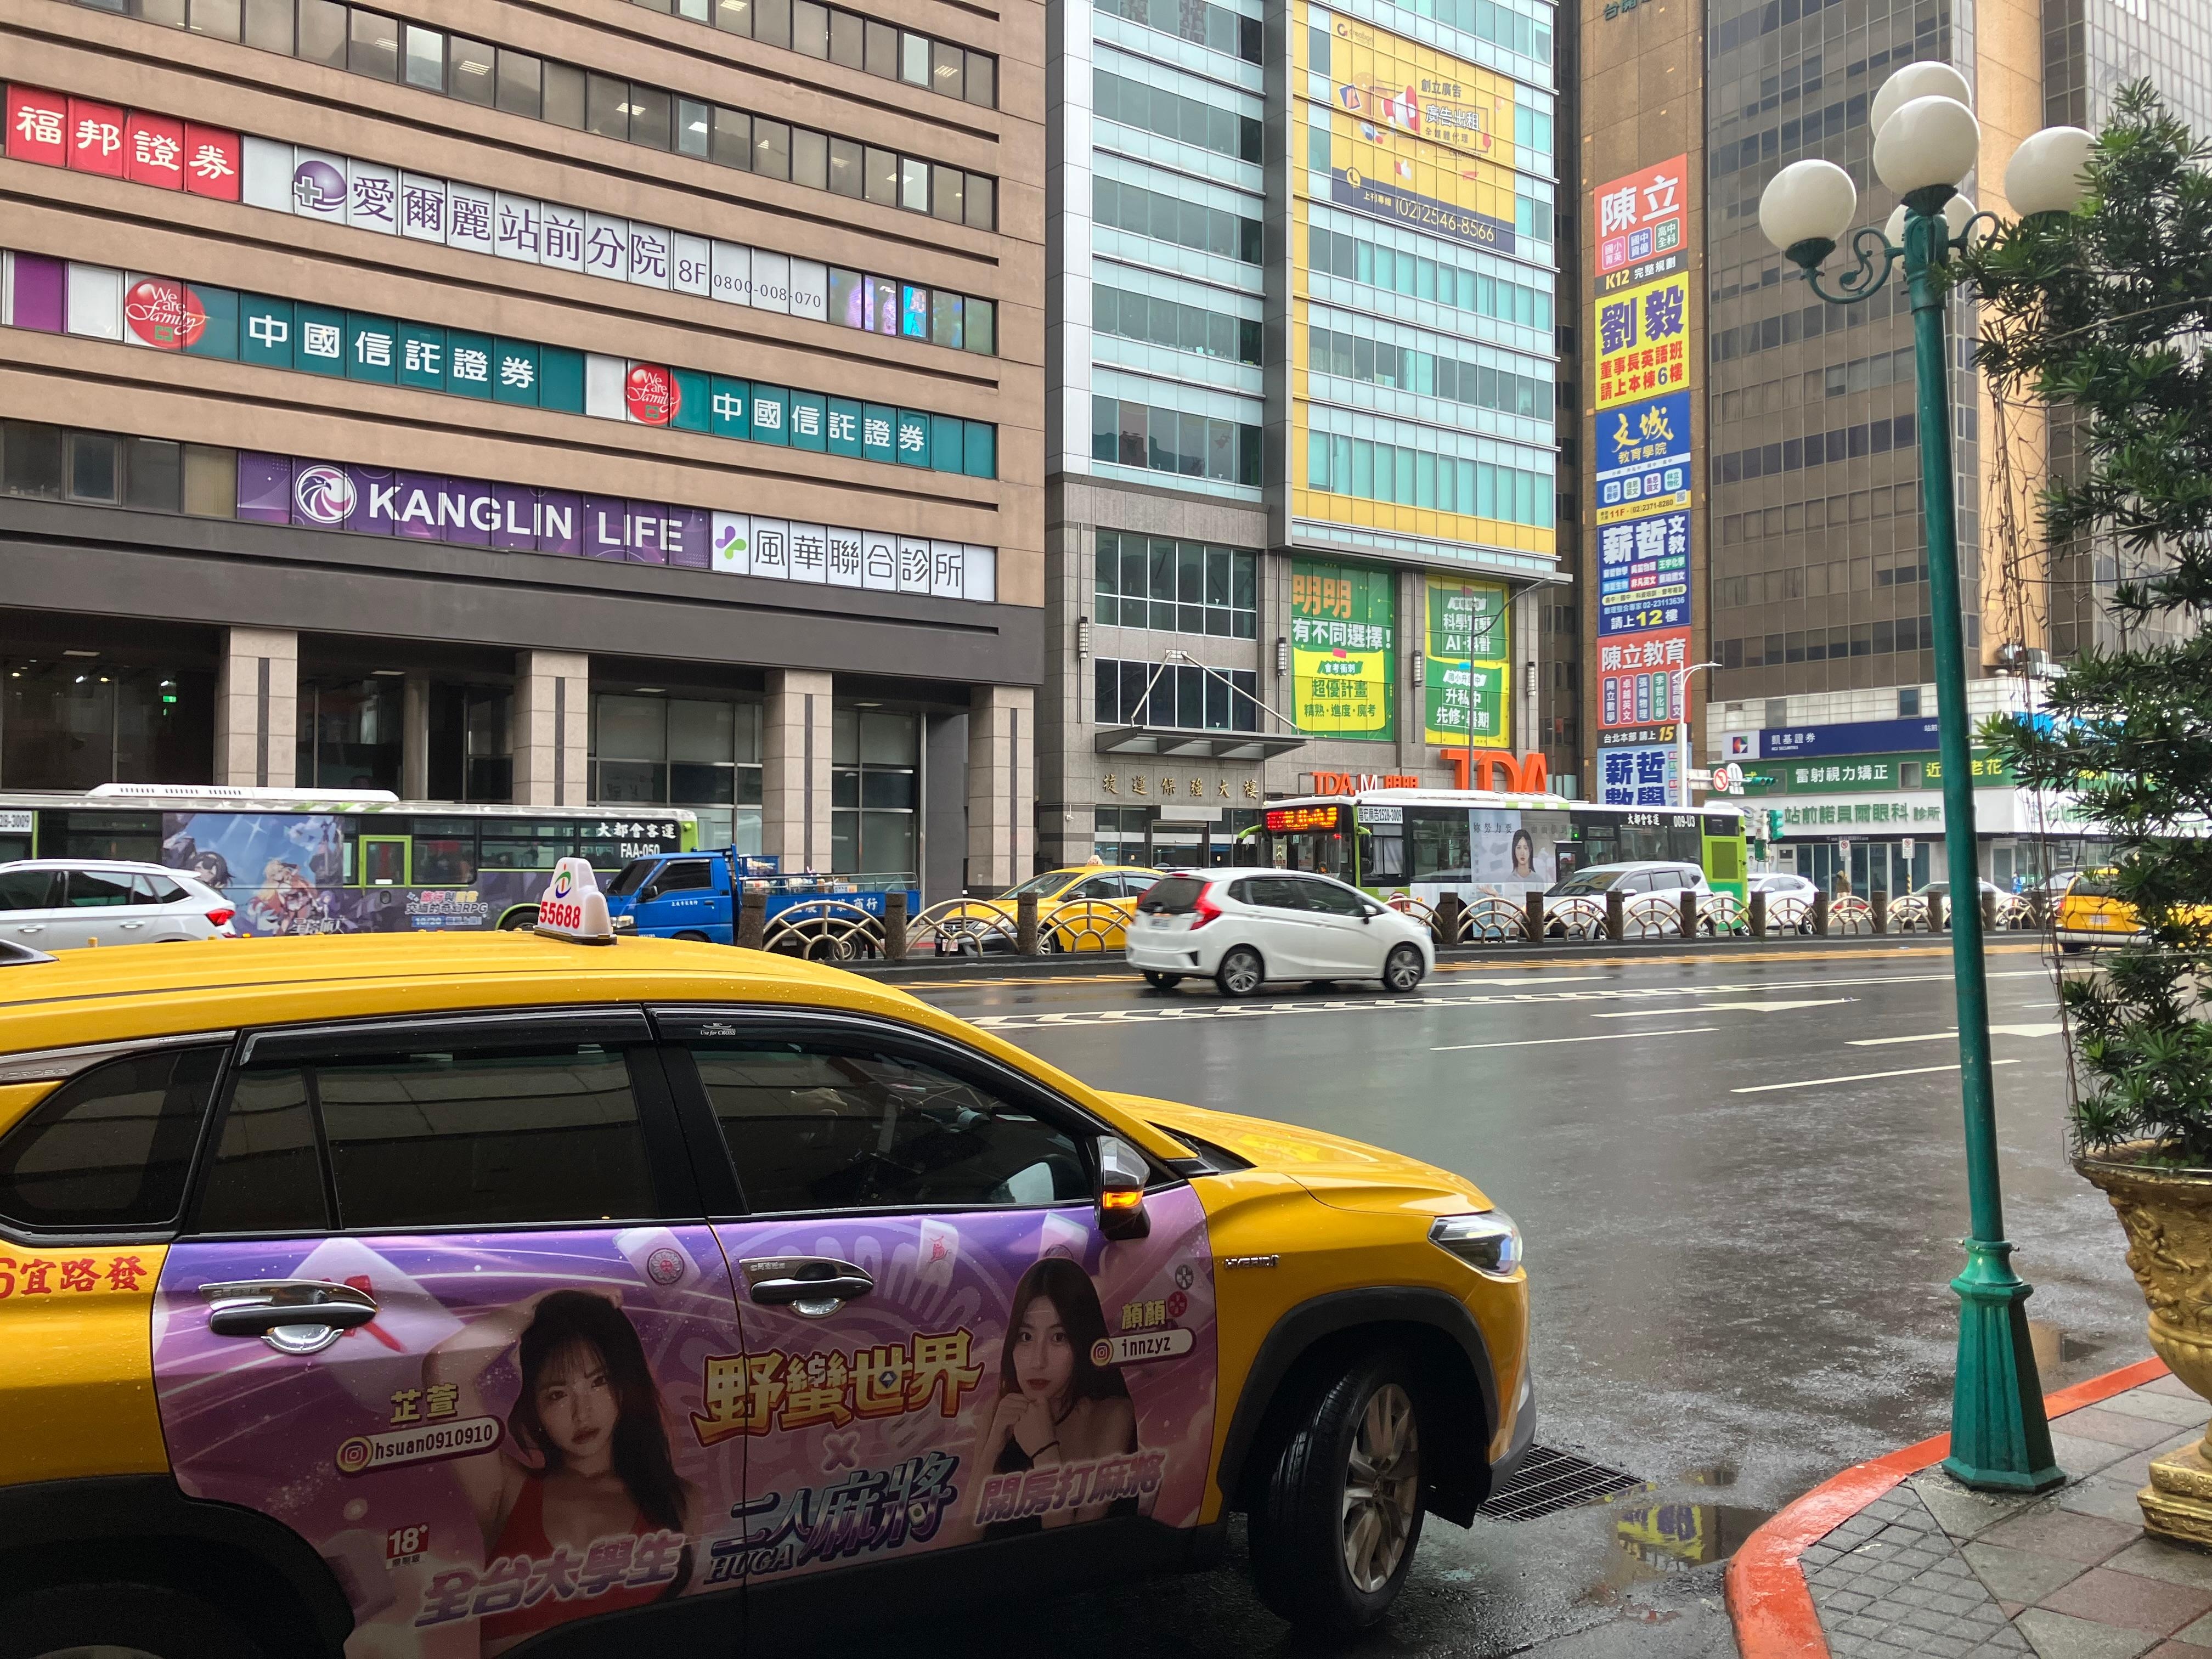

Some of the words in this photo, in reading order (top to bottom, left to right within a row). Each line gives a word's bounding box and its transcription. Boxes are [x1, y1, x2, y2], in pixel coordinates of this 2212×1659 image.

[1421, 78, 1462, 98] 創立廣告
[1426, 104, 1480, 132] 廣告出租
[16, 105, 235, 179] 福邦證券
[1396, 196, 1494, 242] (02)2546-8566
[1601, 174, 1680, 238] 陳立
[353, 176, 667, 279] 愛爾麗站前分院
[679, 259, 707, 285] 8F
[713, 274, 821, 308] 0800-008-070
[1631, 232, 1649, 246] 國中
[1657, 223, 1676, 238] 高中
[1657, 233, 1676, 249] 全科
[1605, 269, 1630, 290] K12
[1634, 256, 1677, 280] 完整規劃
[151, 287, 177, 302] We
[162, 301, 185, 313] are
[1600, 284, 1685, 356] 劉毅
[249, 314, 534, 389] 中國信託證券
[1600, 340, 1683, 380] 董事長英語班
[643, 372, 662, 384] We
[651, 383, 667, 394] are
[1600, 362, 1683, 402] 請上本棟6樓
[713, 392, 924, 452] 中國信託證券
[1612, 405, 1674, 453] 文城
[1618, 442, 1667, 465] 教育學院
[369, 482, 572, 539] KANGLIN
[598, 511, 683, 552] LIFE
[1610, 508, 1625, 518] 11F
[1602, 519, 1667, 565] 薪哲
[1667, 515, 1686, 555] 文教
[755, 529, 962, 588] 風華聯合診所
[1293, 574, 1352, 619] 明明
[1643, 596, 1685, 609] 02-23113636
[1293, 618, 1391, 650] 有不同選擇!
[1611, 608, 1678, 630] 請上12樓
[1324, 663, 1356, 674] 會考衝刺
[1601, 638, 1686, 673] 陳立教育
[1312, 680, 1368, 698] 超優計畫
[1622, 679, 1632, 721] 卓越英文
[1604, 732, 1637, 744] 台北本部
[1639, 726, 1677, 742] 請上15
[1771, 732, 1816, 745] 凱基證券
[1440, 748, 1548, 792] TDA
[1605, 751, 1666, 786] 薪哲
[1796, 764, 1888, 784] 雷射視力矯正
[1102, 773, 1260, 799] 捷運保強大樓
[597, 822, 677, 839] 大都會客運
[1628, 813, 1660, 826] 大都會客運
[1784, 802, 1908, 825] 站前諾貝爾眼科
[1914, 806, 1942, 821] 診所
[620, 843, 661, 859] FAA-050
[539, 901, 582, 929] 55688
[1121, 1299, 1166, 1330] 顏顏
[690, 1325, 985, 1448] 野蠻世界
[390, 1383, 459, 1425] 芷萱
[374, 1424, 494, 1460] hsuan0910910
[974, 1449, 1172, 1526] 開房打麻將
[711, 1451, 962, 1568] 二人麻將
[414, 1529, 687, 1628] 全台大學生
[703, 1544, 794, 1585] HUGA
